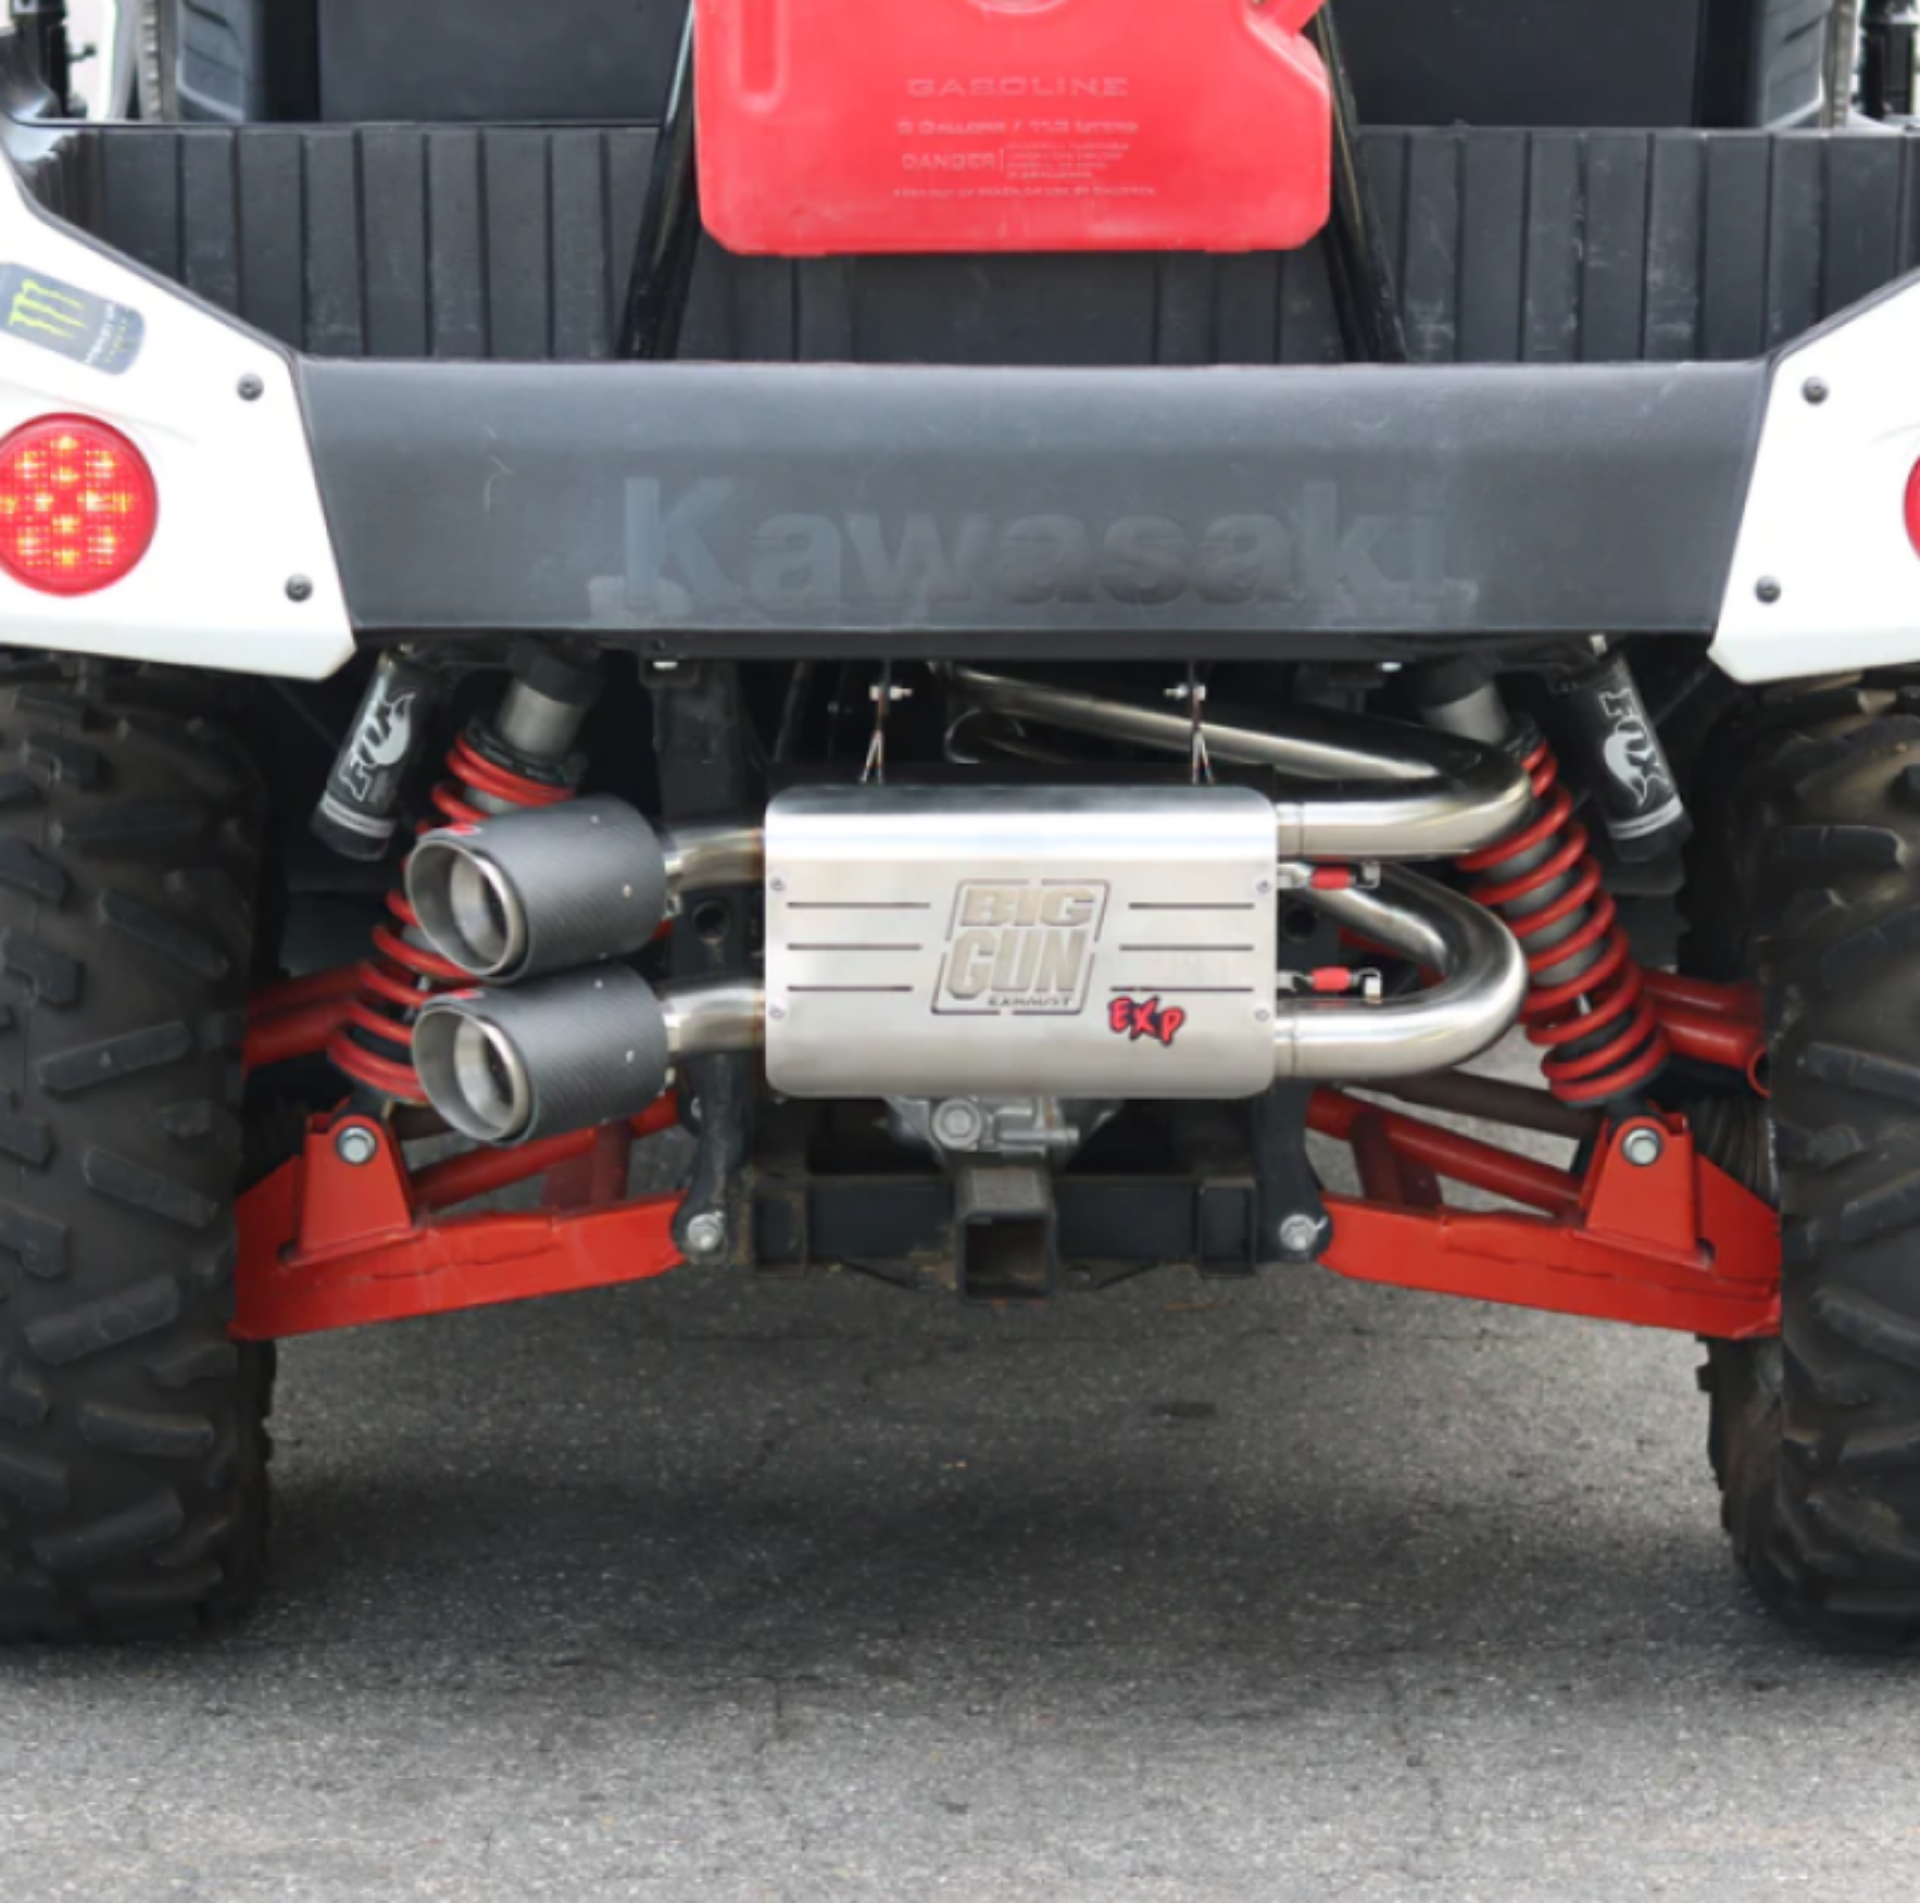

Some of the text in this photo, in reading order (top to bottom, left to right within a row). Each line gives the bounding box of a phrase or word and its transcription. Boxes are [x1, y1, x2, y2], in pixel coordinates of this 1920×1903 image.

[906, 77, 1129, 97] GASOLINE
[901, 151, 996, 170] DANGER
[622, 478, 1447, 604] Kawasaki
[960, 887, 1095, 927] BIG
[946, 929, 1087, 1000] GUN
[1107, 995, 1186, 1047] EXP
